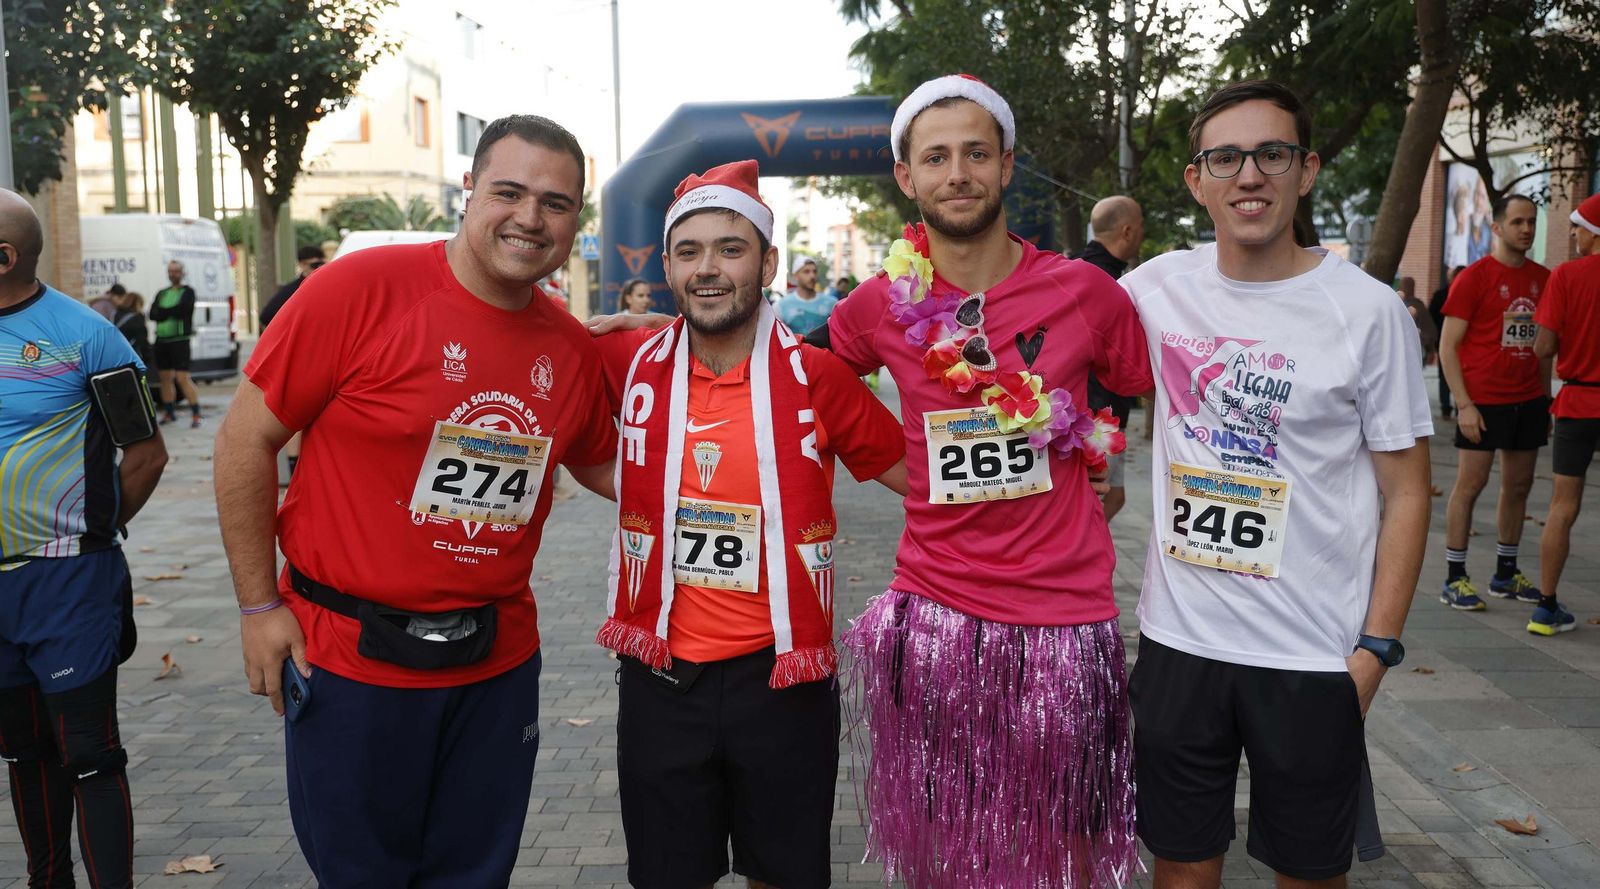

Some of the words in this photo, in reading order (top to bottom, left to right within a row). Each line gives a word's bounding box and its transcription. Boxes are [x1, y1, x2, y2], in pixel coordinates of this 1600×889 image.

[1506, 324, 1535, 338] 486
[443, 359, 466, 372] UCA
[1233, 351, 1296, 374] AMOR
[470, 391, 525, 413] SOLIDARIA
[523, 408, 538, 425] DE
[947, 418, 984, 435] CARRERA
[456, 434, 497, 454] CARRERA
[498, 442, 529, 459] NAVIDAD
[939, 436, 1034, 481] 265
[431, 457, 529, 503] 274
[982, 479, 1004, 488] MATEOS,
[1005, 476, 1022, 485] MIGUEL
[1182, 473, 1219, 494] CARRERA
[1221, 480, 1263, 501] NAVIDAD
[452, 497, 471, 506] MARTÍN
[700, 510, 736, 525] NAVIDAD
[1173, 497, 1267, 549] 246
[490, 523, 518, 532] EVOS
[433, 540, 499, 556] CUPRA
[674, 530, 743, 569] 78
[1216, 545, 1234, 555] MARIO
[454, 555, 480, 564] TURIAL
[718, 569, 734, 577] PABLO
